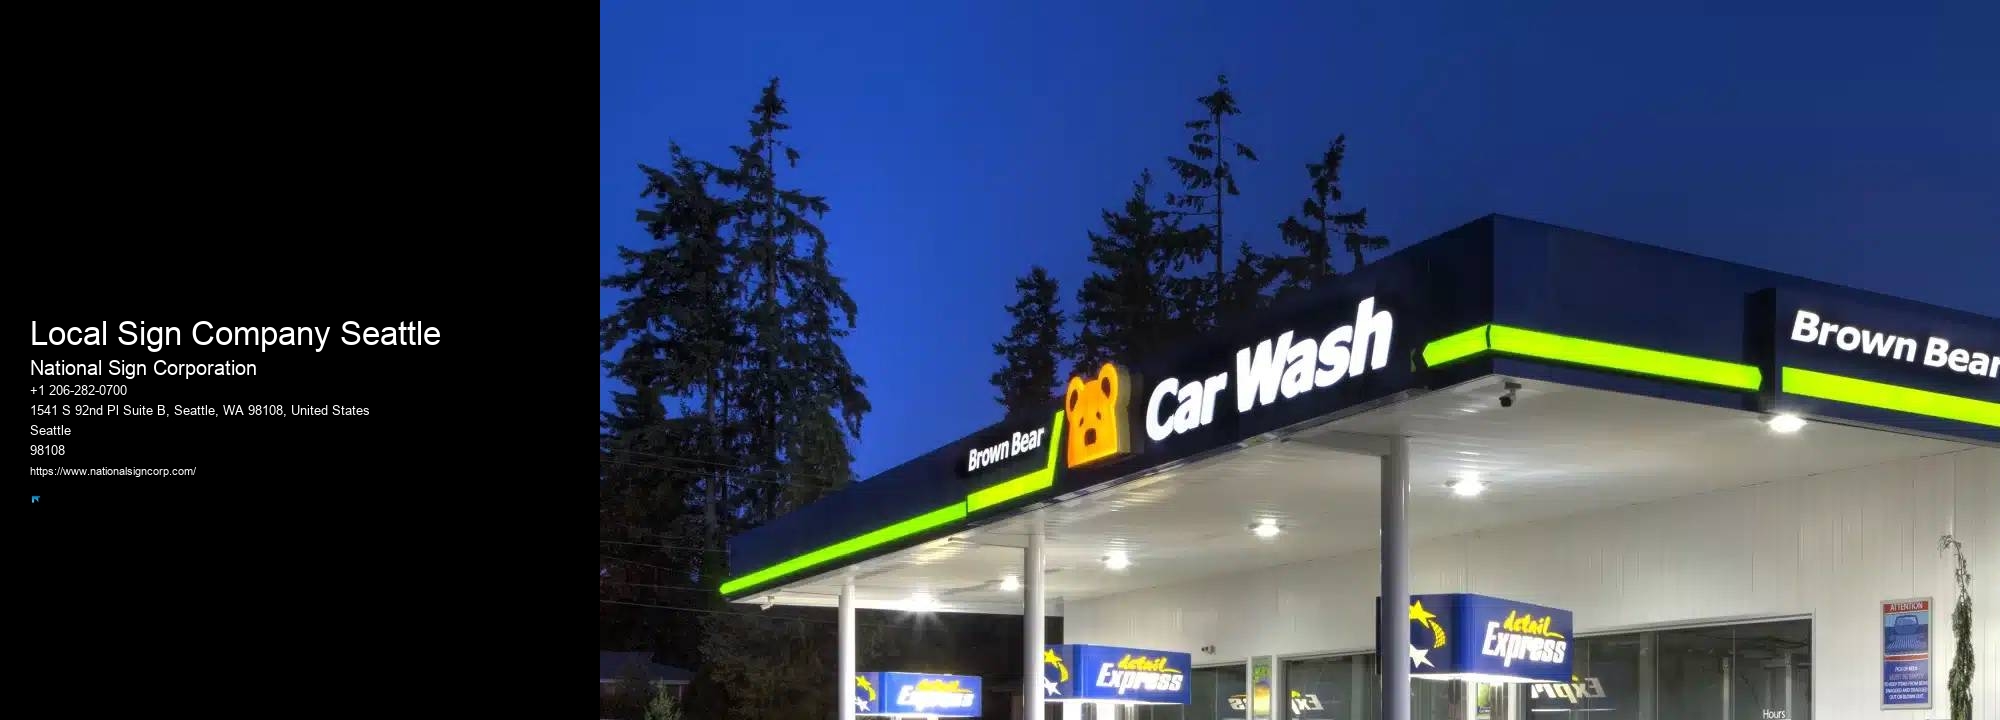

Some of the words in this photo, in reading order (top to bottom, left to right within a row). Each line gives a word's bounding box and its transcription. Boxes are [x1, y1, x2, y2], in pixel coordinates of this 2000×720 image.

[1790, 309, 1918, 363] Brown
[1923, 336, 2000, 378] Bear
[1145, 371, 1228, 441] Car
[1236, 296, 1393, 413] Wash
[968, 440, 1010, 472] Brown
[1010, 427, 1045, 457] Bear
[1481, 620, 1567, 668] Express
[1503, 609, 1565, 639] detail
[1095, 662, 1184, 695] Express
[1762, 708, 1786, 720] Hours
